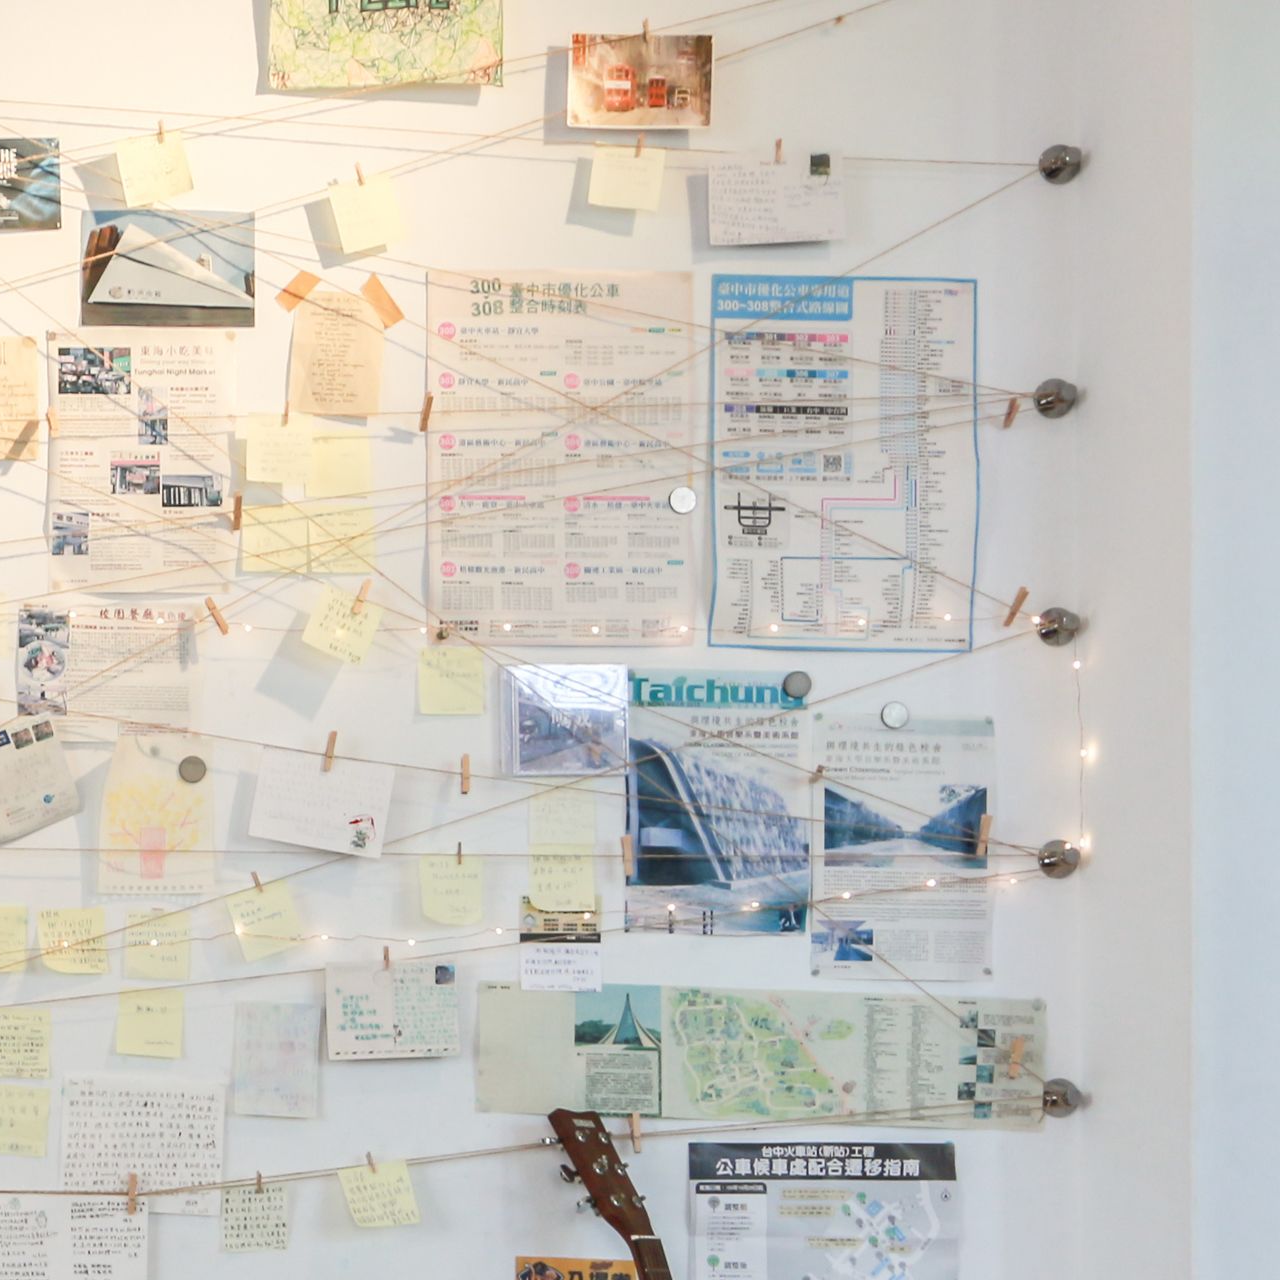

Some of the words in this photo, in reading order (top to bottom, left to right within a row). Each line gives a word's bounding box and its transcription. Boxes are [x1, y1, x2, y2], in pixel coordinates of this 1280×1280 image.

[470, 278, 502, 295] 300
[509, 282, 621, 298] 臺中市優化公車
[471, 300, 504, 317] 308
[166, 368, 188, 377] Night
[761, 1145, 875, 1158] 台中火車站(新站)工程
[715, 1158, 920, 1177] 公車候車處配合遷移指南
